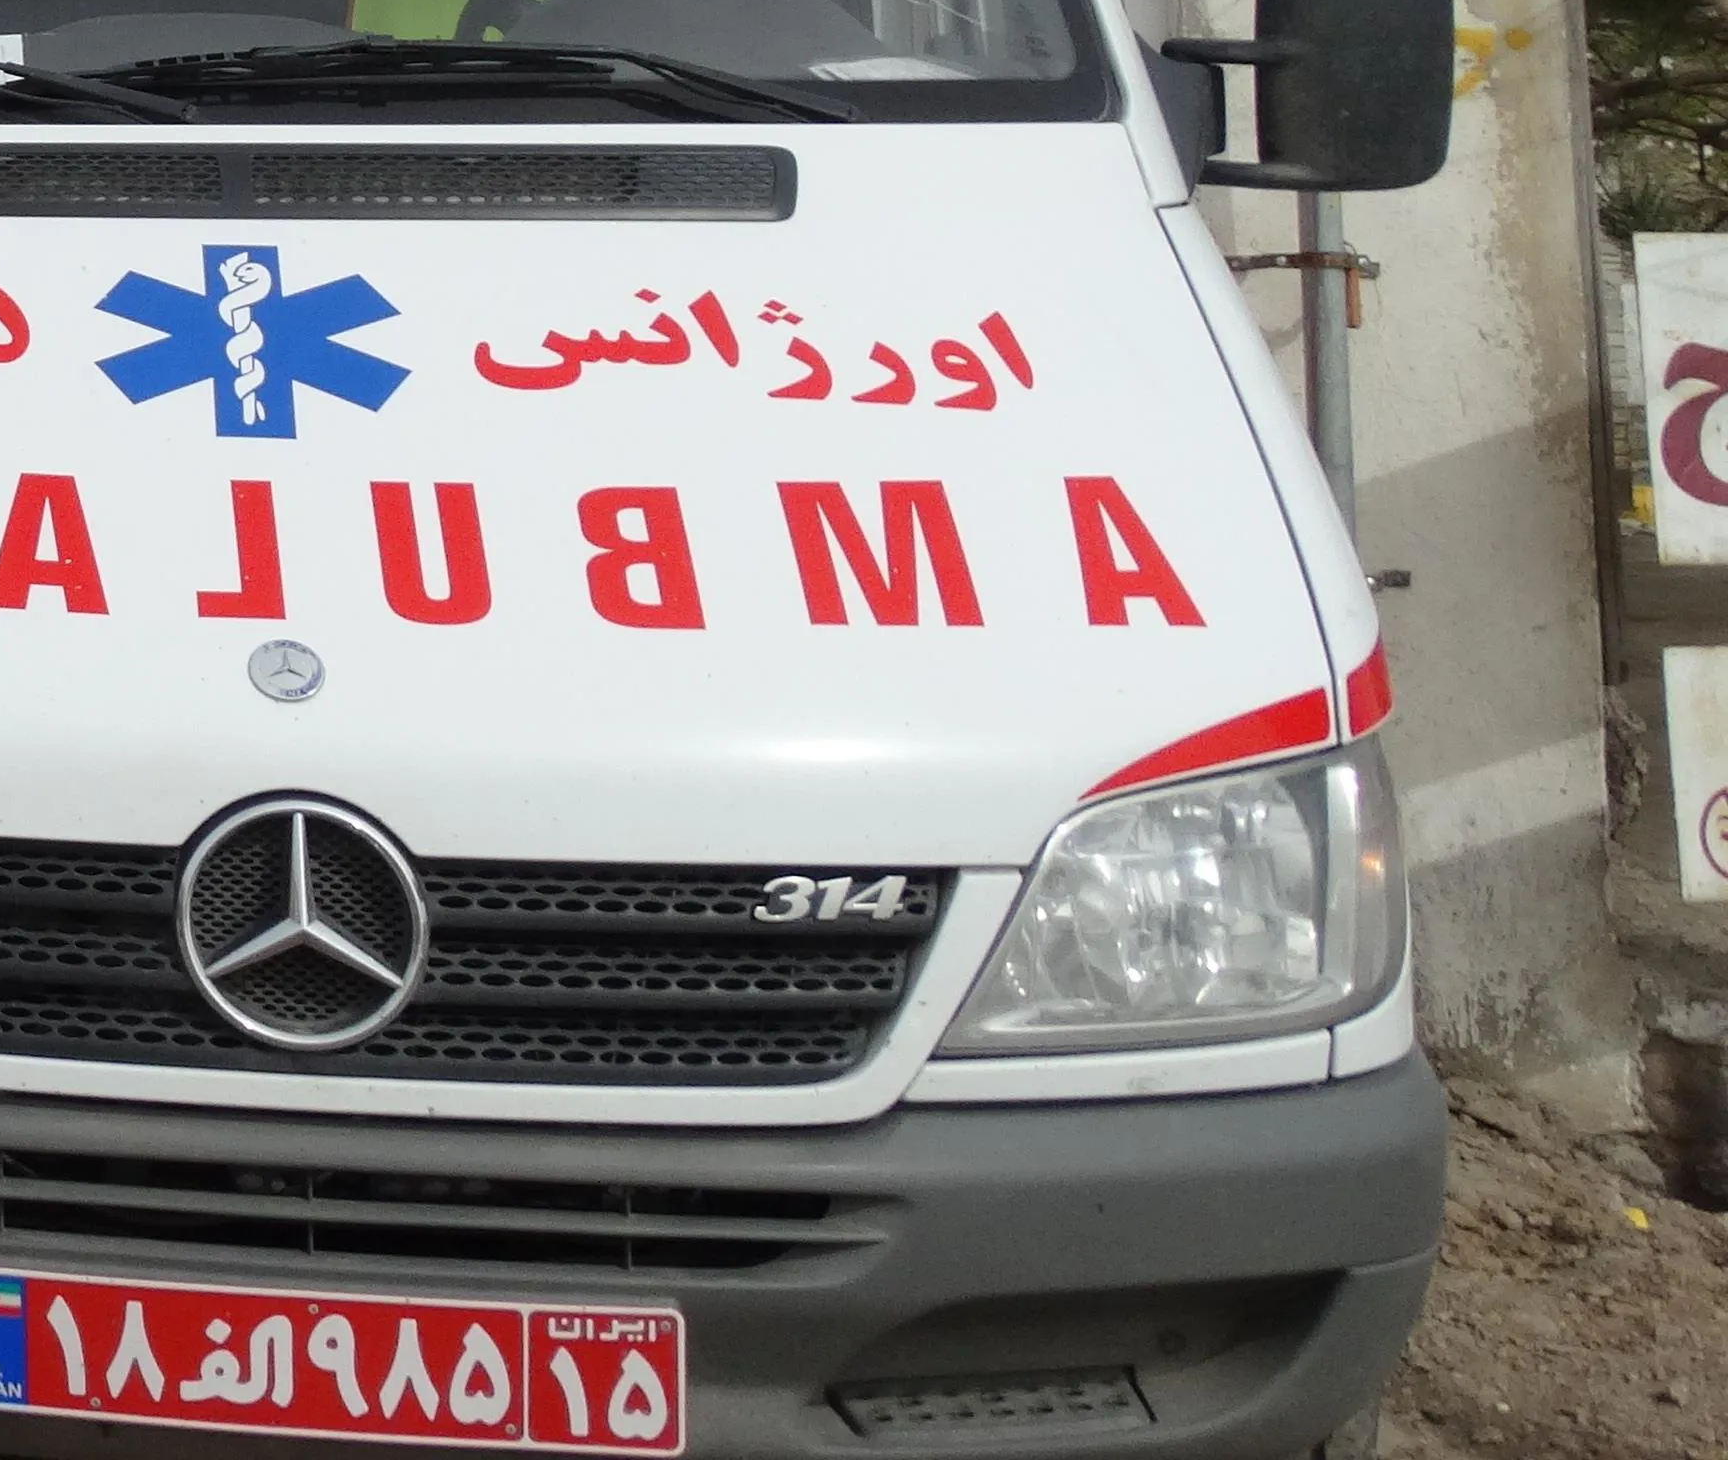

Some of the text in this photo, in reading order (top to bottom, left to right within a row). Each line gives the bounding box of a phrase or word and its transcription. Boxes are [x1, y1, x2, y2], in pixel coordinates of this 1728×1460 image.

[474, 288, 1034, 412] اورژانس
[752, 874, 907, 923] 314
[546, 1316, 657, 1343] ایران
[548, 1345, 670, 1442] ۱۵
